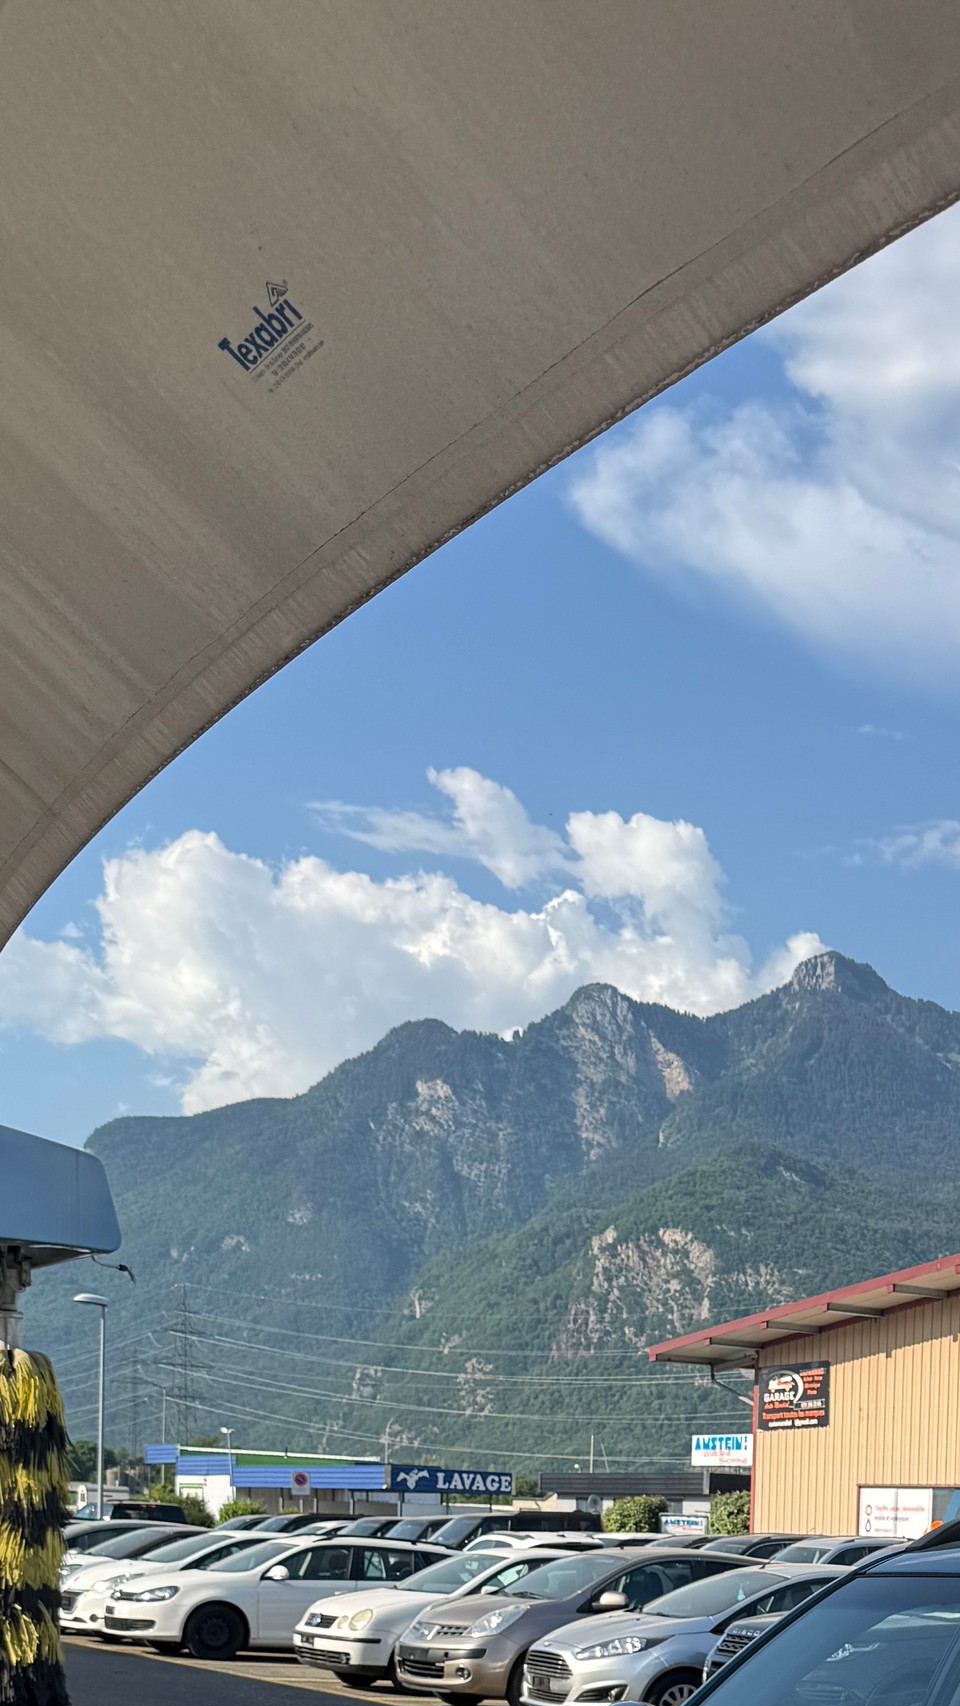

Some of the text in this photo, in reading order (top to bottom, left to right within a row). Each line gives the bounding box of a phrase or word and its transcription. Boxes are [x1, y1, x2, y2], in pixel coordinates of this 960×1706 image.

[218, 299, 303, 372] Texabri
[763, 1391, 796, 1403] GARAGE
[695, 1436, 742, 1451] AMSTEIN
[436, 1472, 512, 1492] LAVAGE
